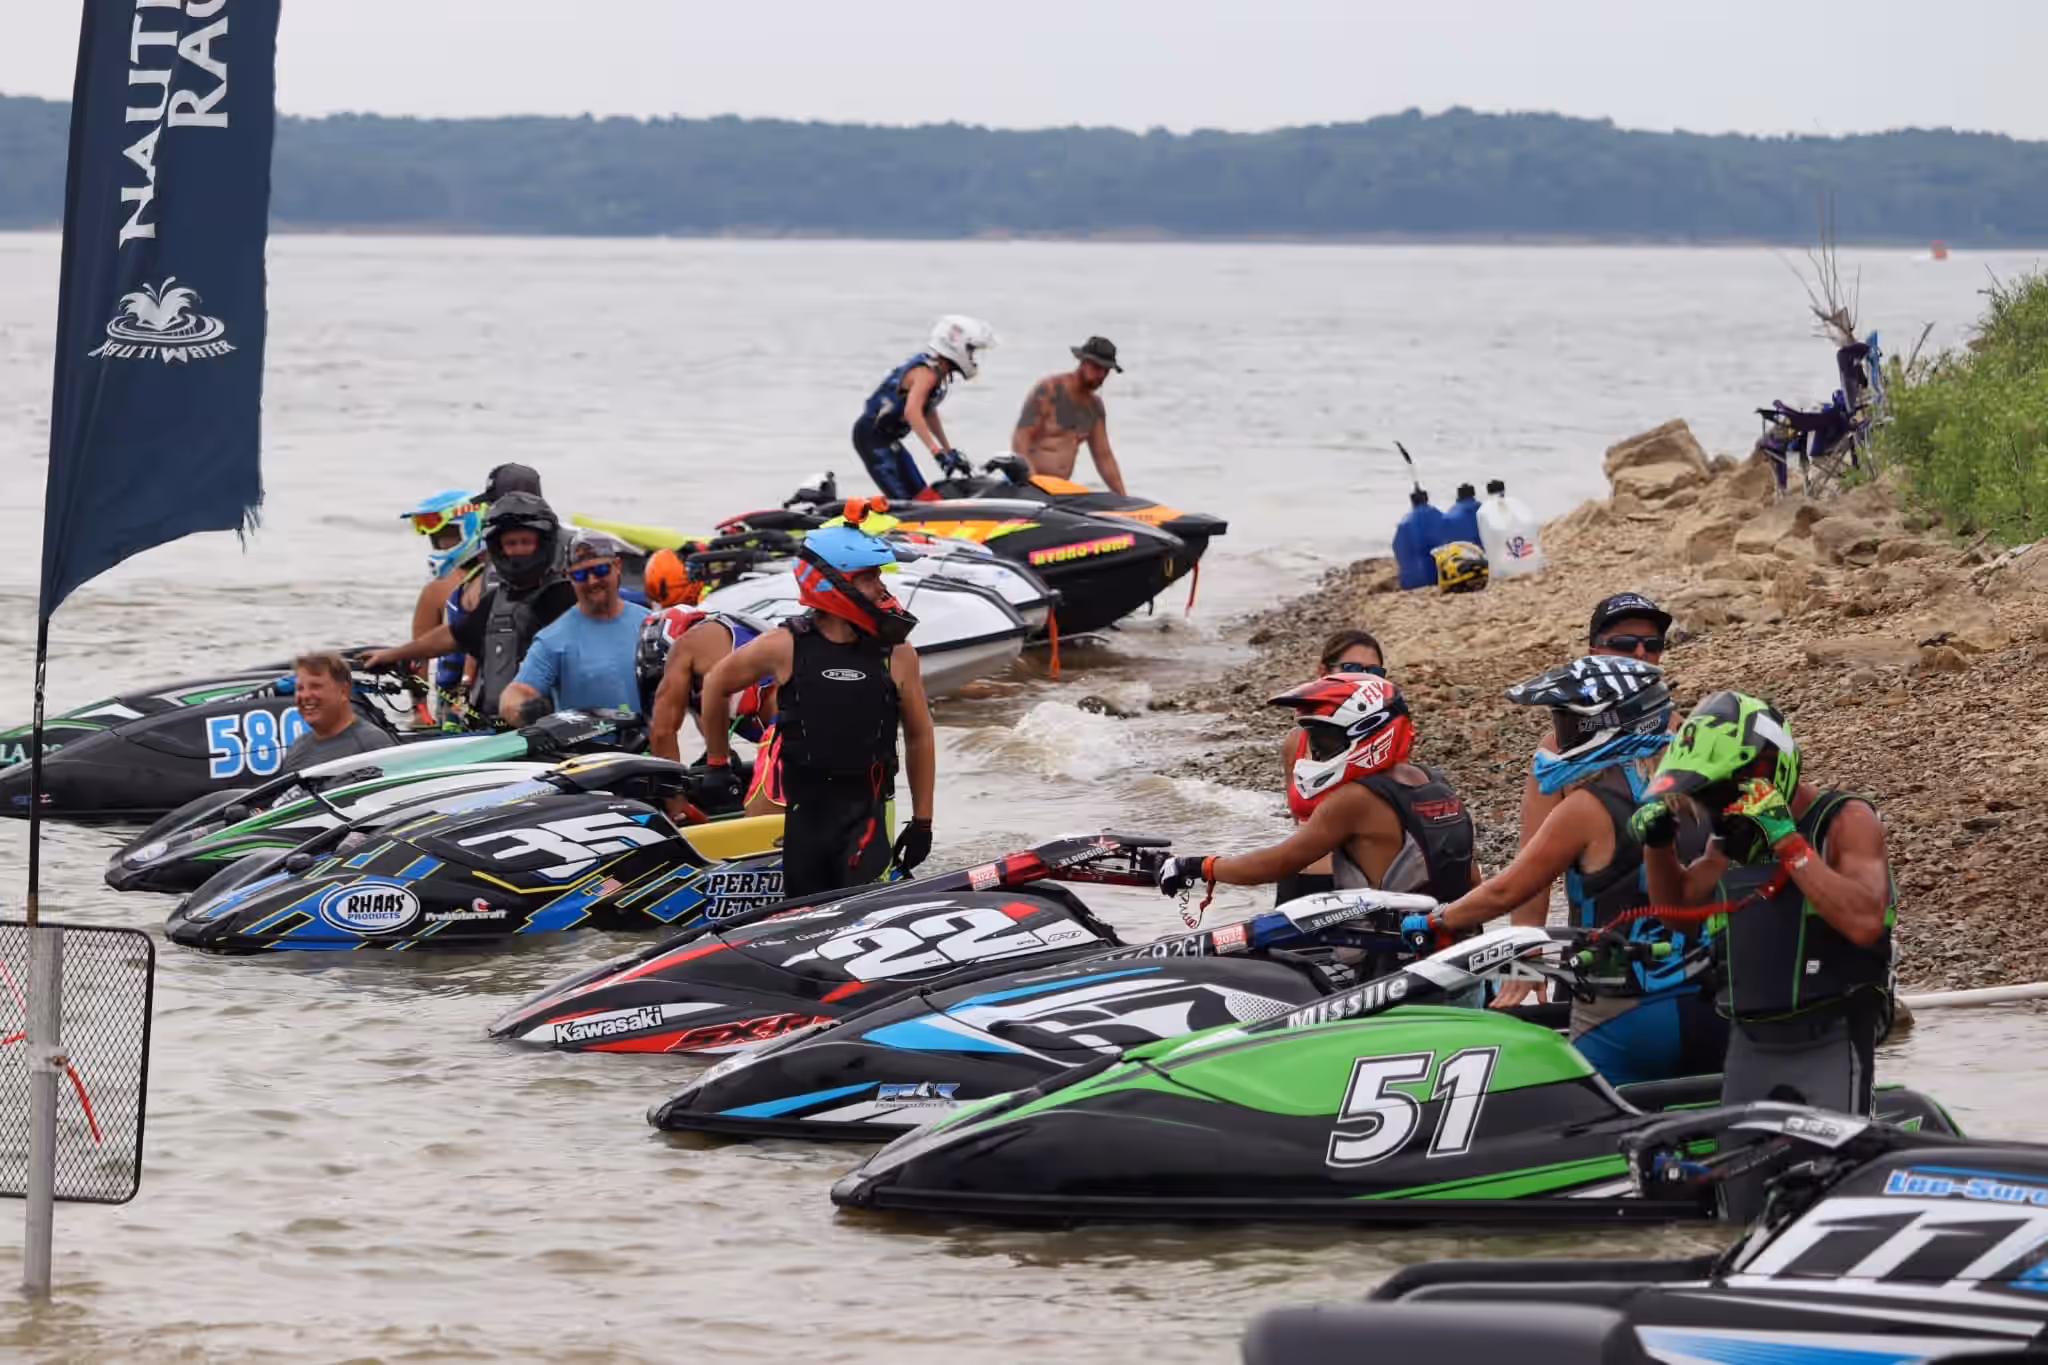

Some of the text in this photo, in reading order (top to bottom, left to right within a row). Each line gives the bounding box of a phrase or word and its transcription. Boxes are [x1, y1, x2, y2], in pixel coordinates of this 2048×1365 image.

[348, 894, 405, 913] RHAAS
[348, 912, 400, 920] PRODUCTS
[815, 908, 1046, 982] 22
[553, 1004, 664, 1045] Kawasaki
[1325, 1045, 1501, 1168] 51
